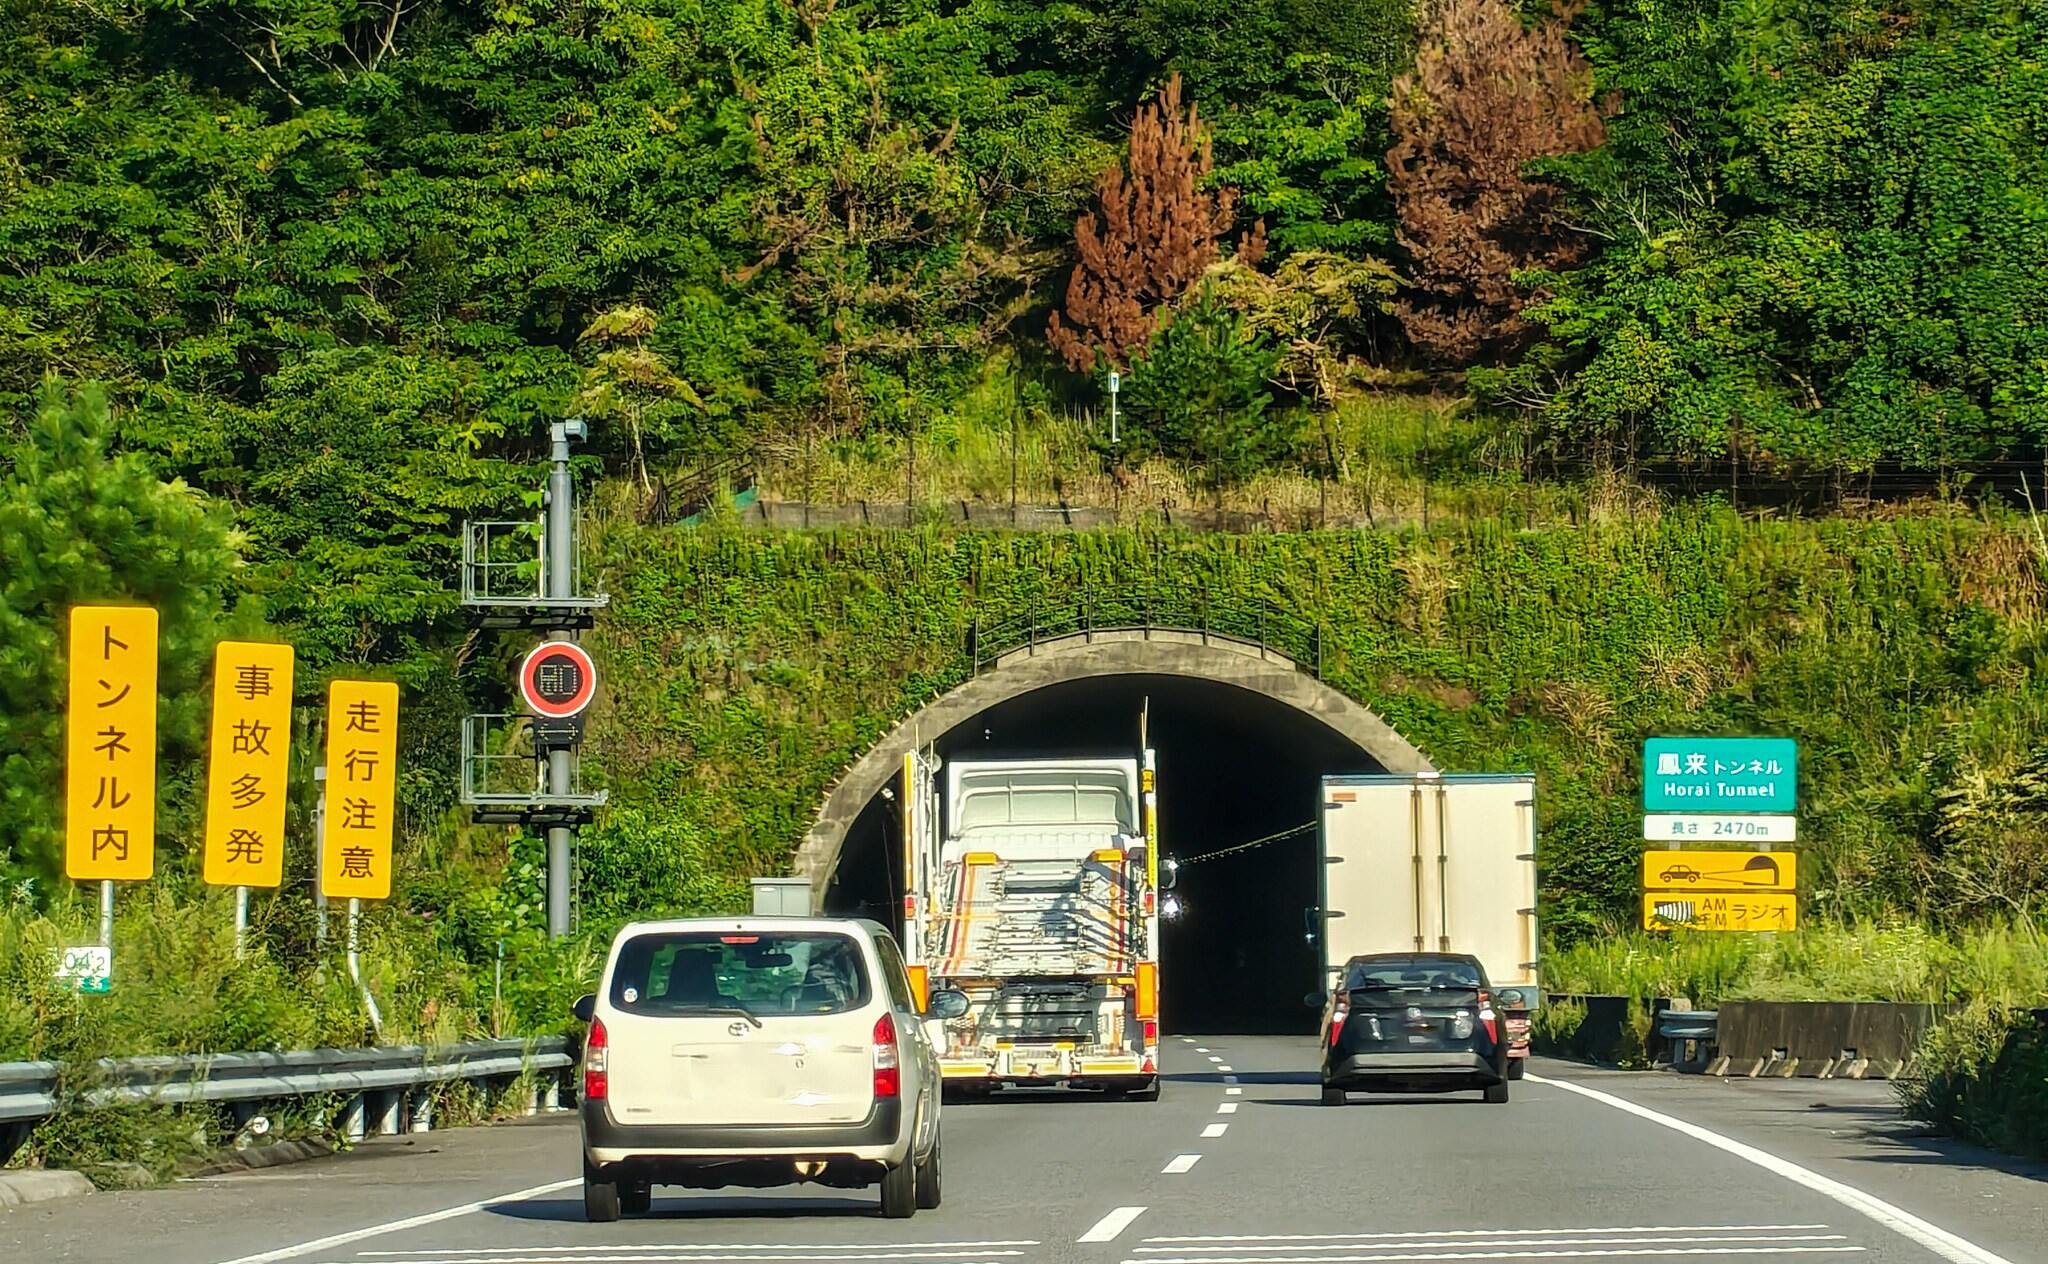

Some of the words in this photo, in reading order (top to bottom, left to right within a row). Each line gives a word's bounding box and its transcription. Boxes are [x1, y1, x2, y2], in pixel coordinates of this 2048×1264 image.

[92, 624, 132, 862] トンネル内
[226, 663, 275, 865] 事故多発
[340, 699, 382, 879] 走行注意
[1664, 782, 1710, 797] Horai
[1716, 782, 1775, 797] Tunnel
[1671, 821, 1699, 835] 長さ
[1713, 822, 1769, 836] 2470m
[1702, 897, 1727, 911] AM
[1731, 904, 1789, 921] ラジオ
